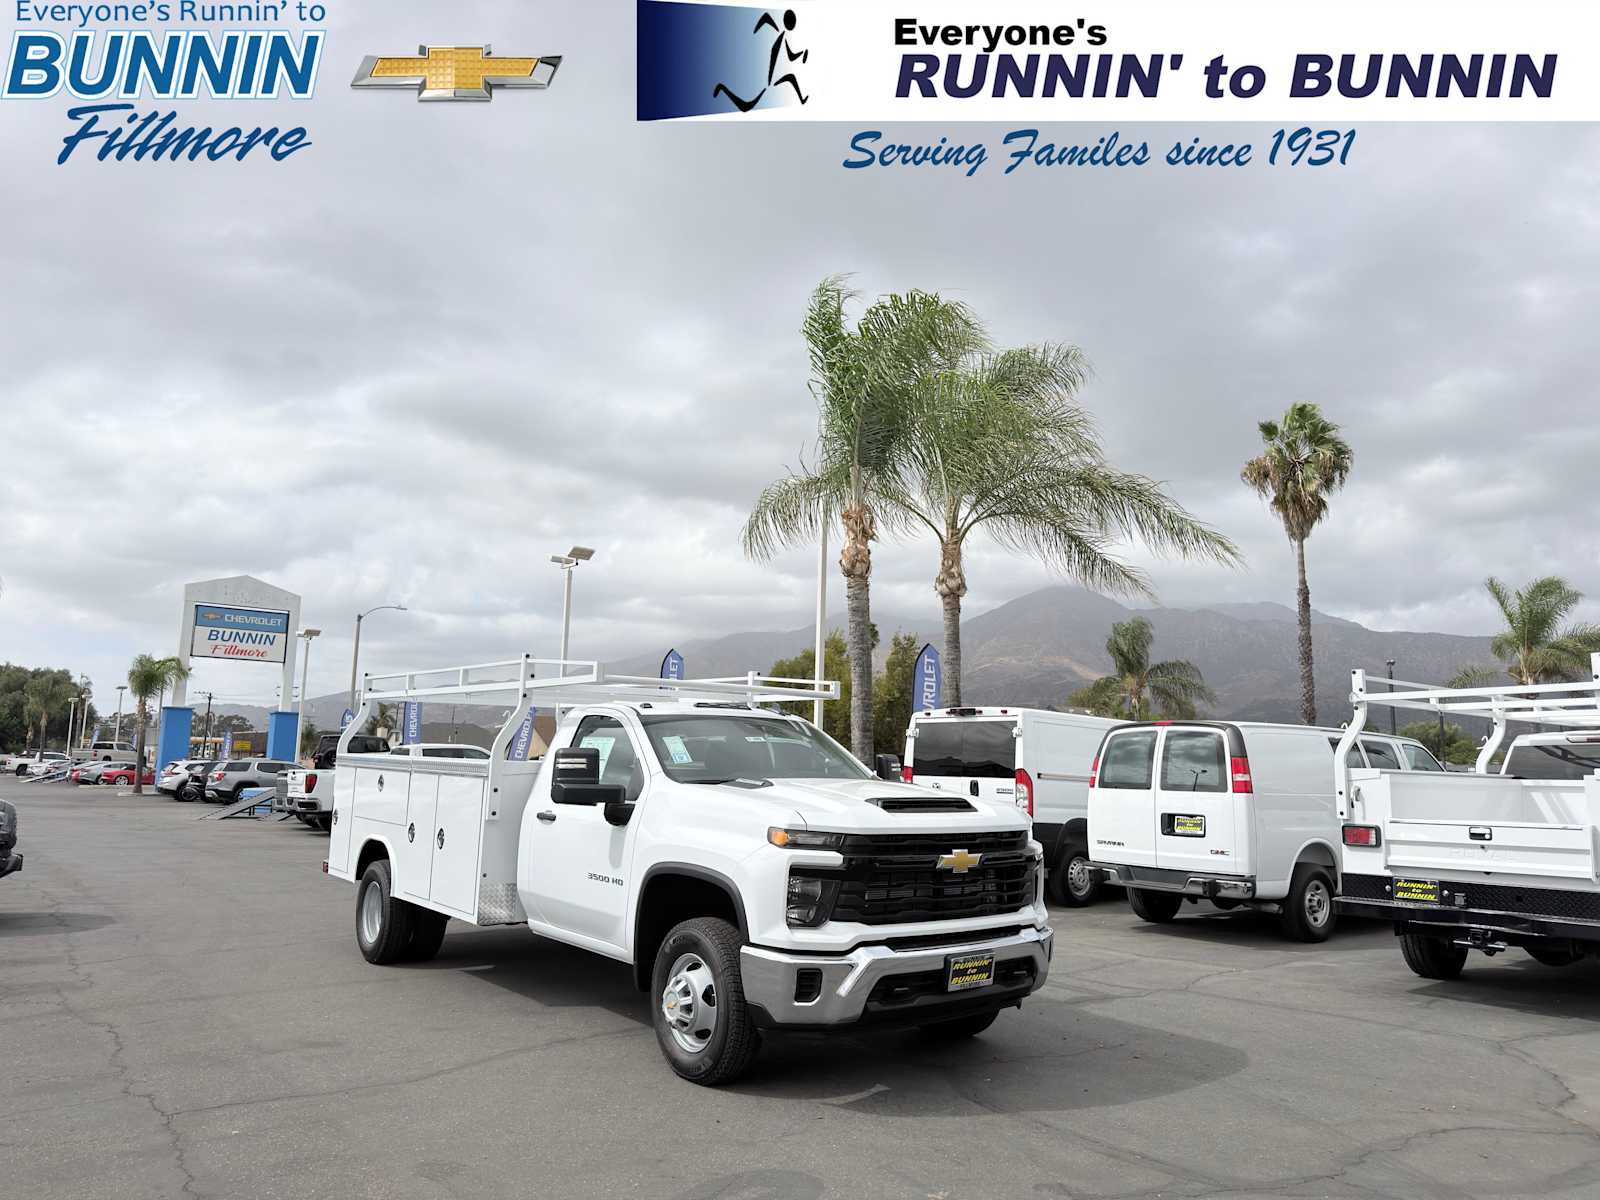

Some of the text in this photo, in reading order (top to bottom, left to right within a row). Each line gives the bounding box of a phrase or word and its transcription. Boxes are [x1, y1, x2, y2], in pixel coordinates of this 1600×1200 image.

[225, 614, 281, 626] CHEVROLET
[207, 629, 276, 646] BUNNIN
[210, 644, 268, 658] Fillmore
[923, 655, 936, 710] VROLET
[587, 872, 623, 886] 3500 HD
[1396, 891, 1436, 900] BUNNIN
[951, 973, 988, 985] BUNNIN
